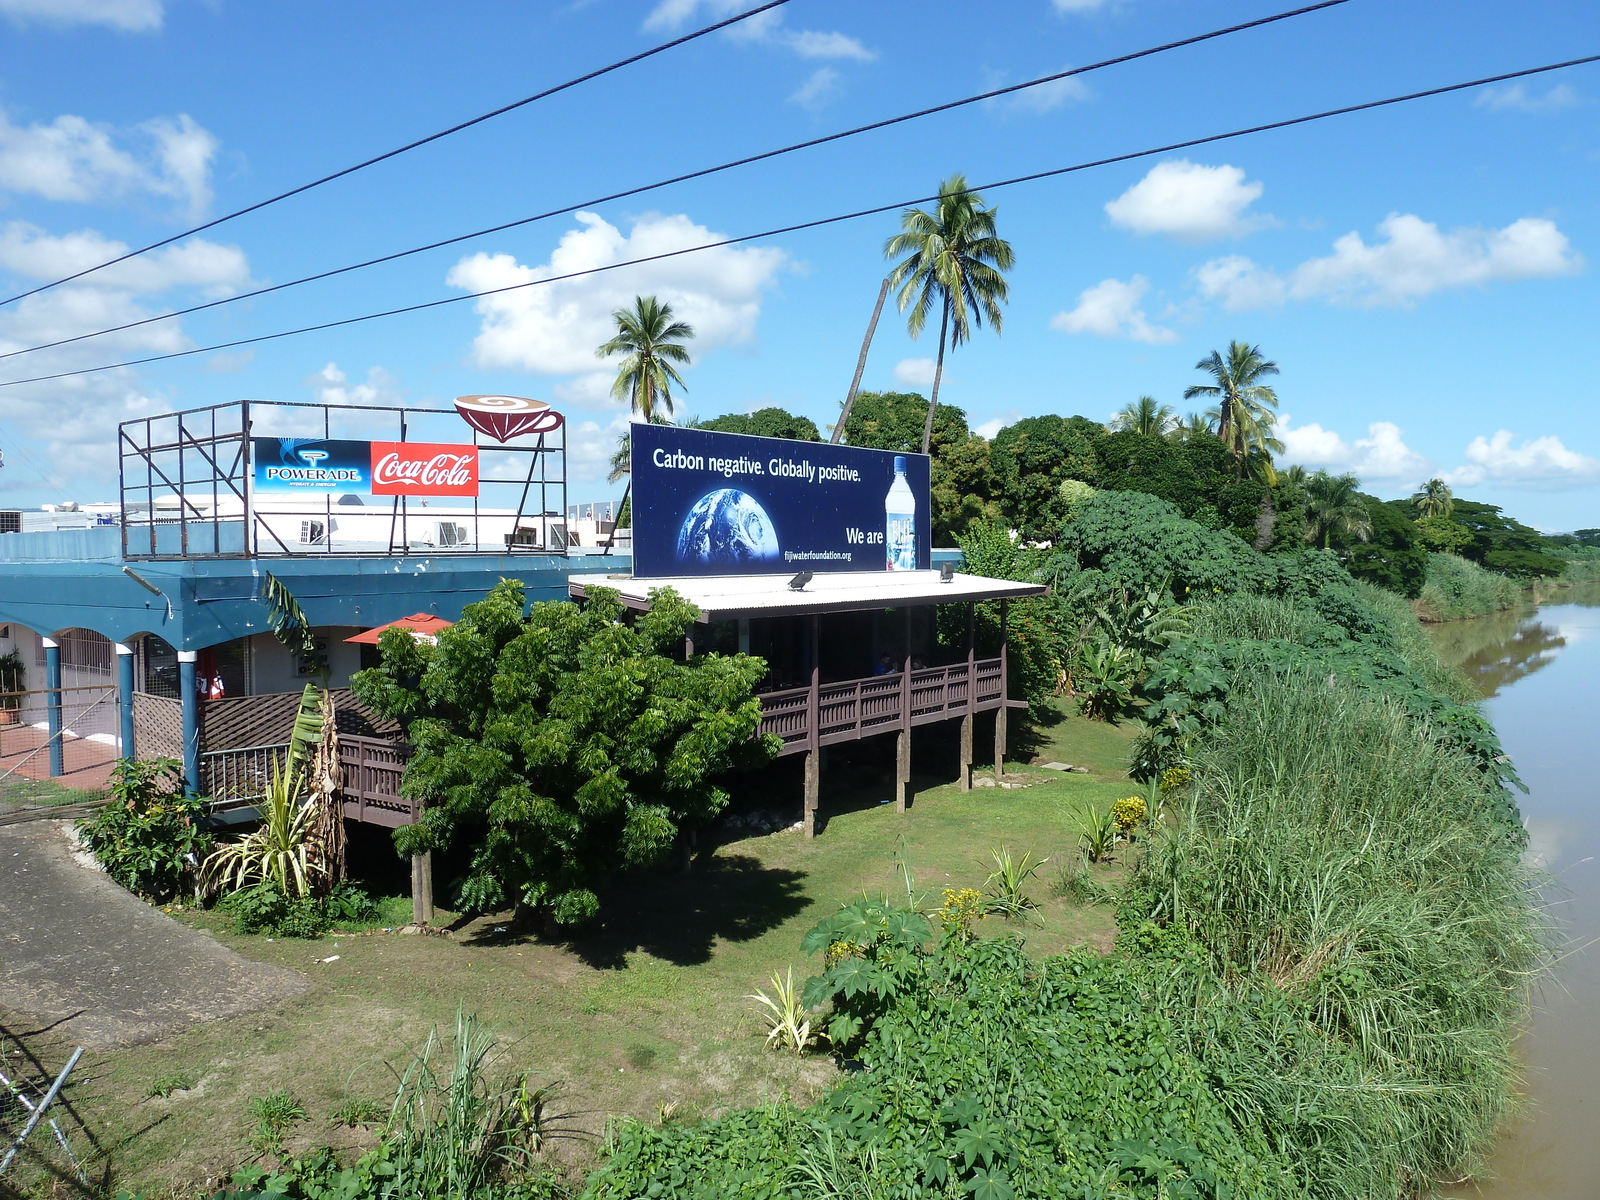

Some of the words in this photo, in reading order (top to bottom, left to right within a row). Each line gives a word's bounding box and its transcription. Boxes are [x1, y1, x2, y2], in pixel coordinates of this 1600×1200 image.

[267, 468, 357, 481] POWERADE
[373, 452, 476, 486] Coca-Cola
[653, 448, 704, 470] Carbon
[708, 456, 765, 478] negative.
[768, 458, 816, 483] Globally
[818, 464, 862, 484] positive.
[846, 527, 864, 545] We
[866, 531, 884, 545] are
[784, 550, 852, 562] fijiwaterfoundation.org
